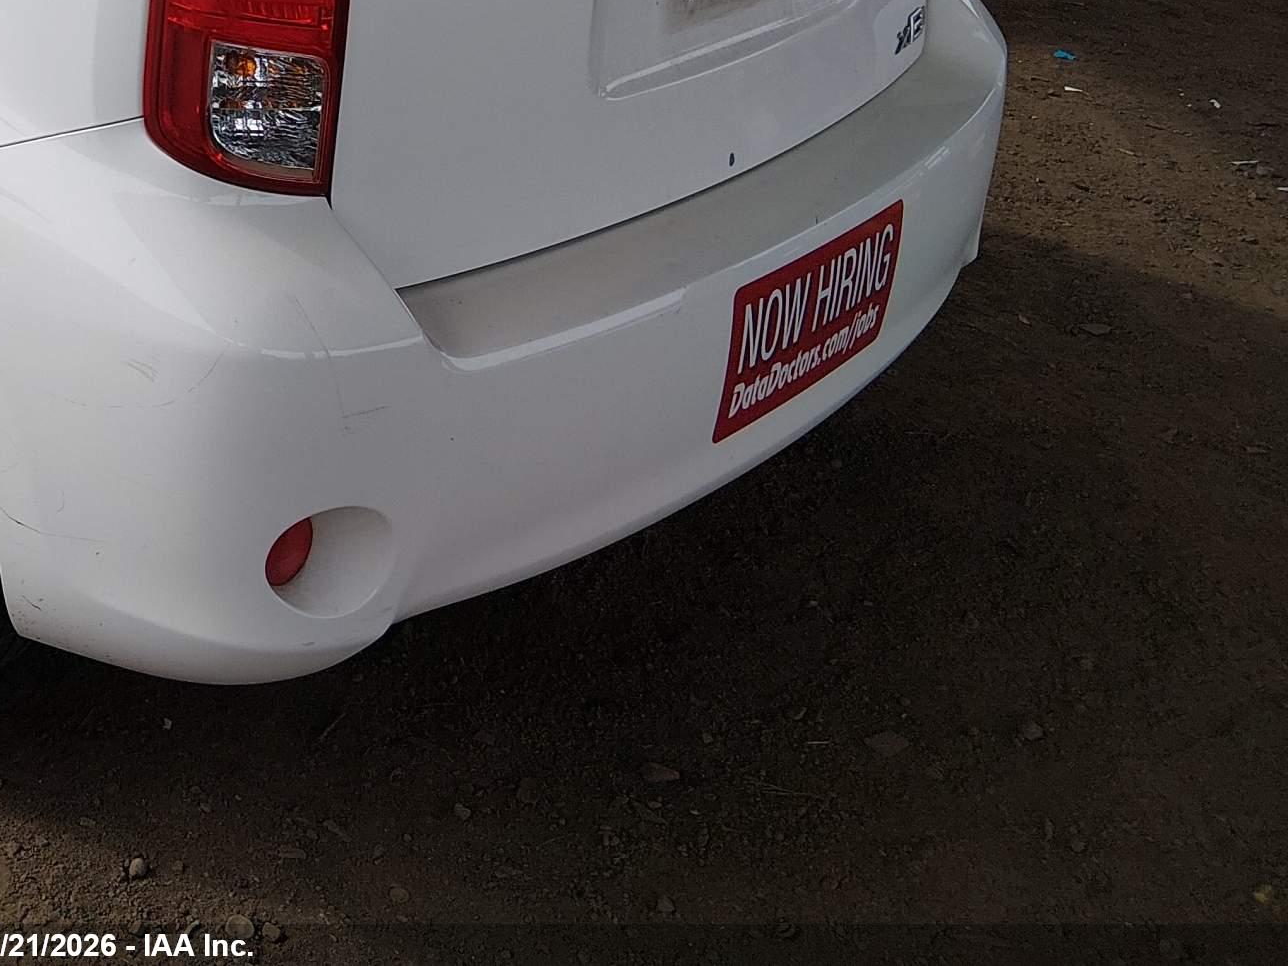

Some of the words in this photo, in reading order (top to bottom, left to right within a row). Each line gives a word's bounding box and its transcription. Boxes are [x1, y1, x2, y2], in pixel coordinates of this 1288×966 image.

[728, 303, 881, 419] DataDoctors.com/jobs
[737, 271, 813, 375] NOW
[811, 222, 894, 332] HIRING
